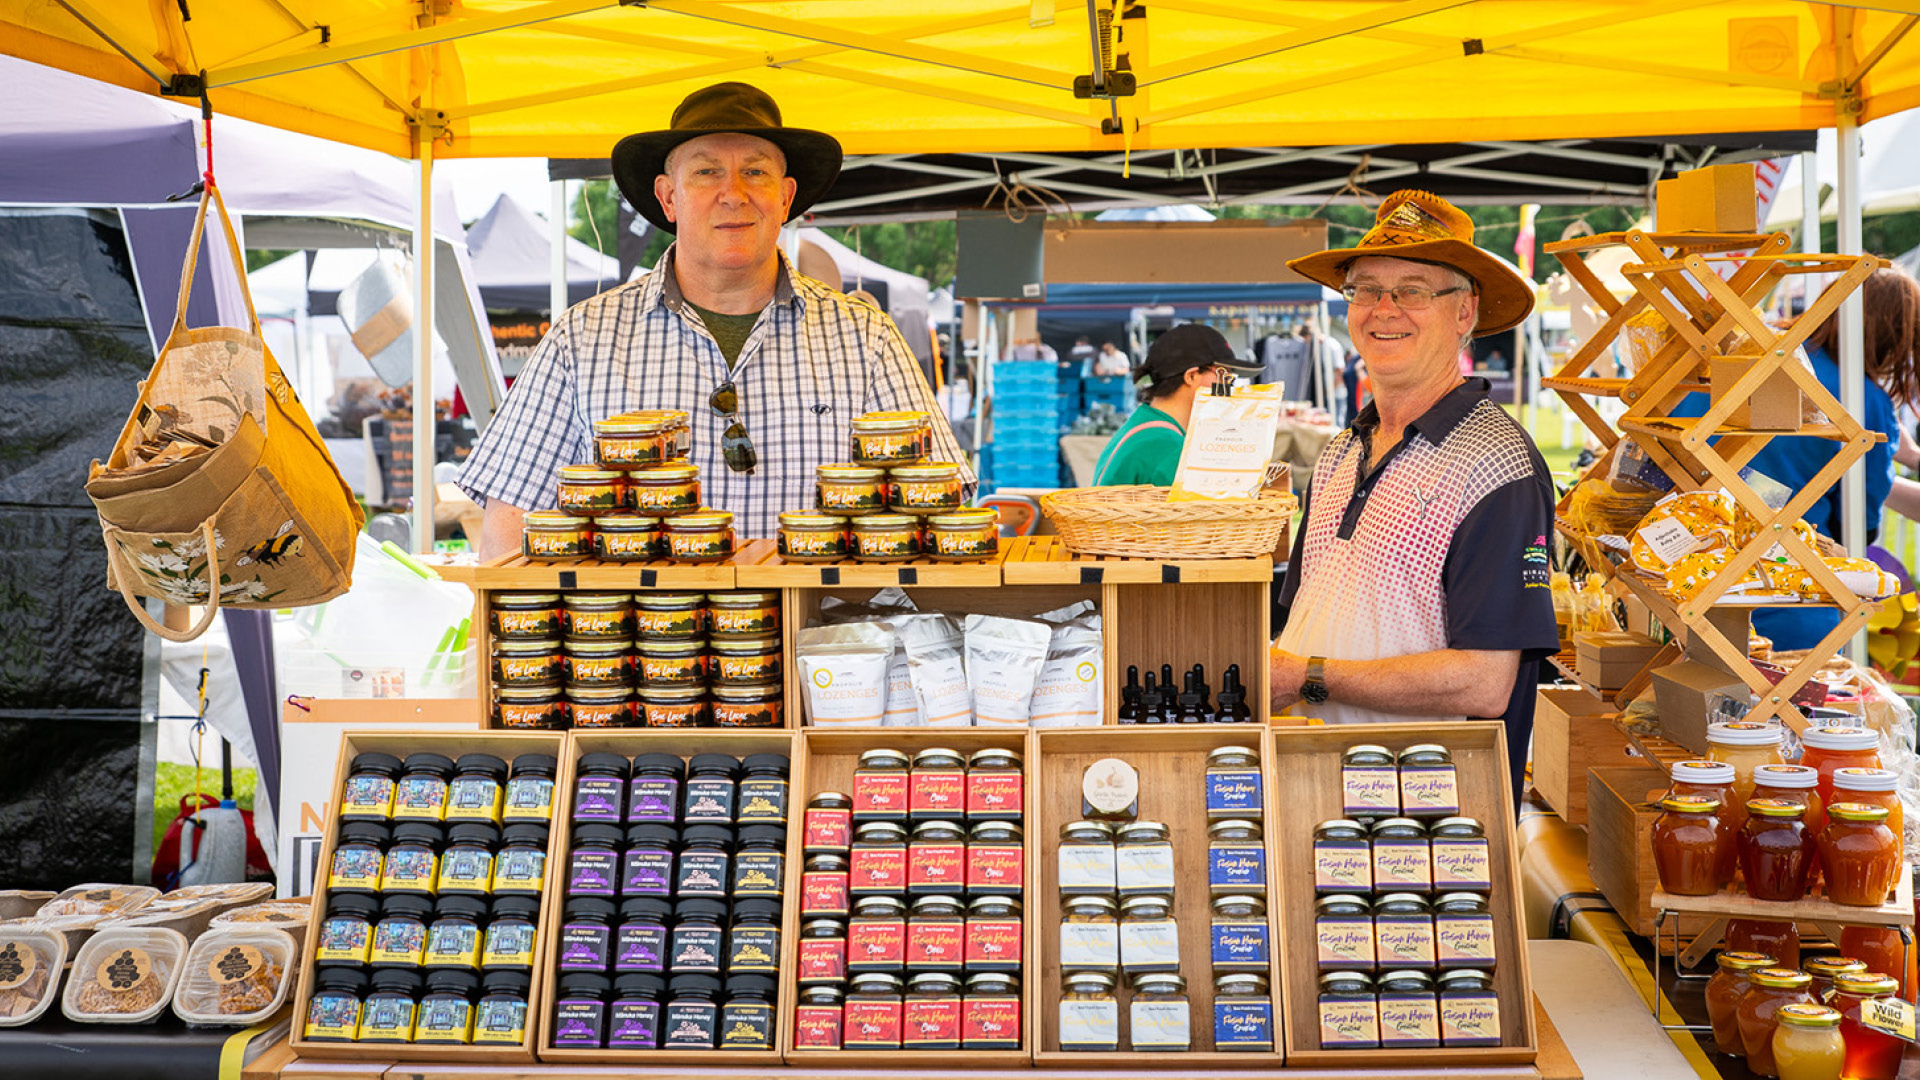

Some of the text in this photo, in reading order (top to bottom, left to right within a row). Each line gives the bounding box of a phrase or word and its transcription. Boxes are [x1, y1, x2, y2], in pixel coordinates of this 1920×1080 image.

[1199, 443, 1257, 453] LOZENGES
[816, 688, 879, 700] LOZENGES
[1033, 684, 1089, 698] OZENGES
[1875, 1005, 1902, 1019] Wild
[1873, 1013, 1904, 1027] Flower
